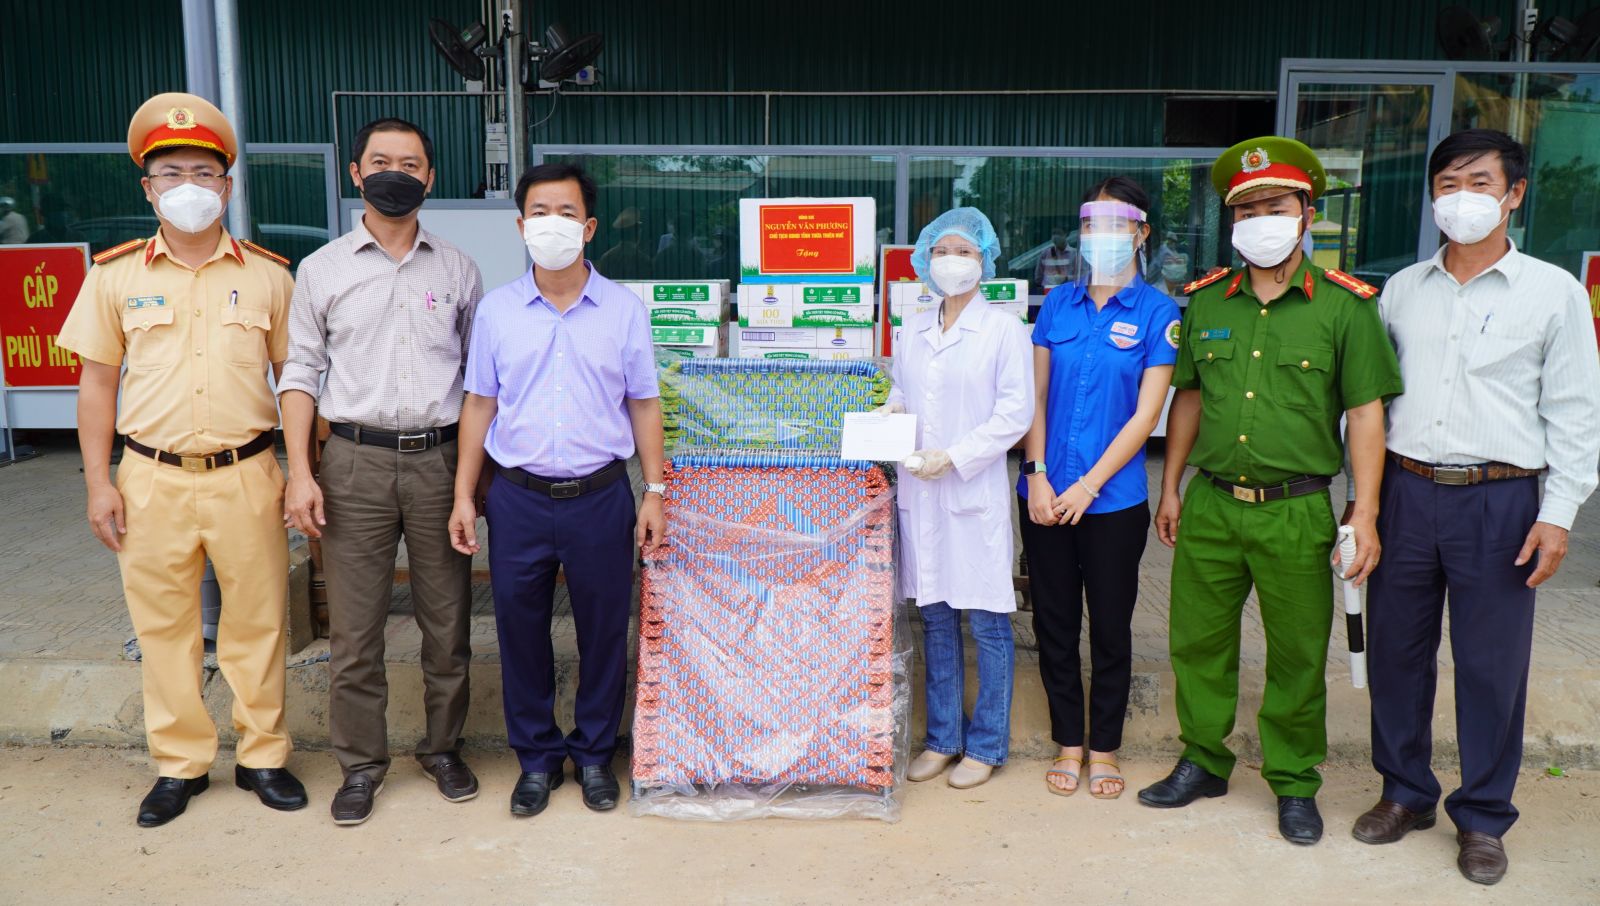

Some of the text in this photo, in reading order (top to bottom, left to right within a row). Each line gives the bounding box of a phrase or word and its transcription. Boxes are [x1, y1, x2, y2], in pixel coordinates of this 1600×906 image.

[765, 220, 848, 230] NGUYỄN VĂN PHƯƠNG
[796, 248, 819, 257] Tặng
[23, 261, 59, 309] CẤP
[763, 309, 780, 319] 100
[6, 326, 42, 368] PHÙ
